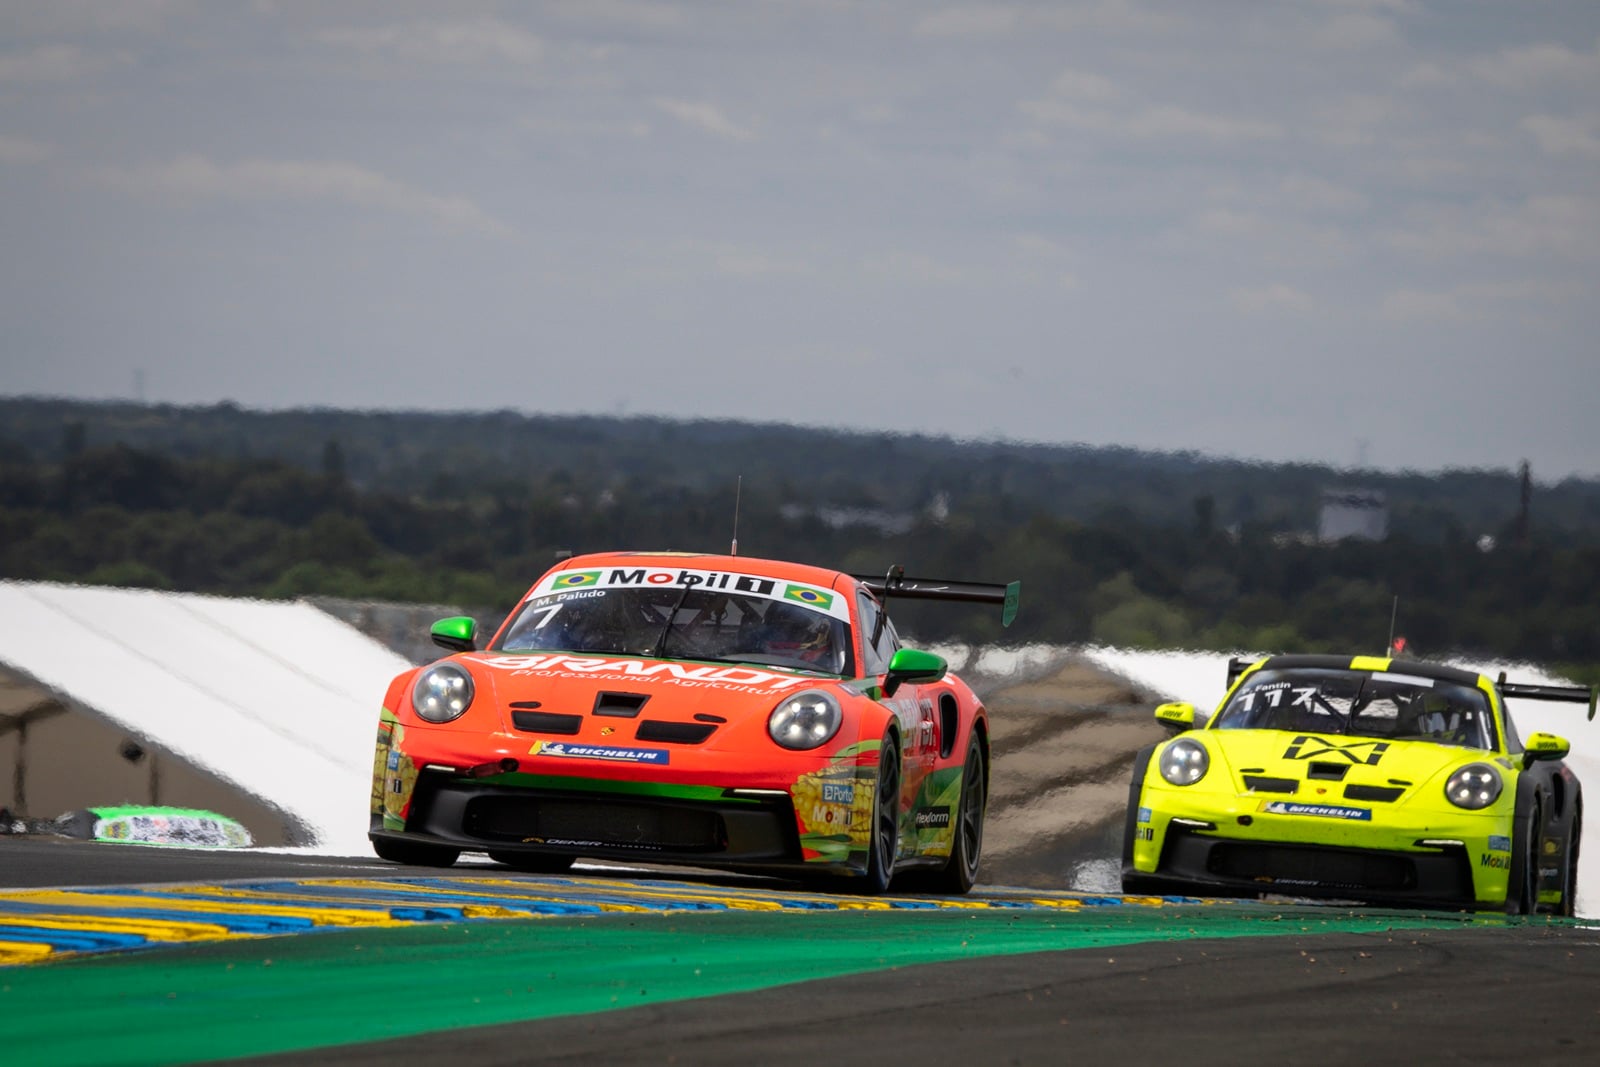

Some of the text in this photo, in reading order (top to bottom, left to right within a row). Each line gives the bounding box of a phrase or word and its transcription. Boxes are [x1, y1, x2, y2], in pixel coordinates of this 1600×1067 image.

[608, 569, 730, 589] Mobil
[536, 589, 606, 607] M. Paludo
[533, 603, 564, 630] 7
[463, 655, 814, 689] BRANDT
[510, 669, 661, 682] Professional
[1255, 682, 1291, 692] Fantin
[1237, 687, 1317, 712] 117
[568, 747, 658, 759] MICHELIN
[833, 786, 853, 802] Porto
[1288, 805, 1363, 818] MICHELIN
